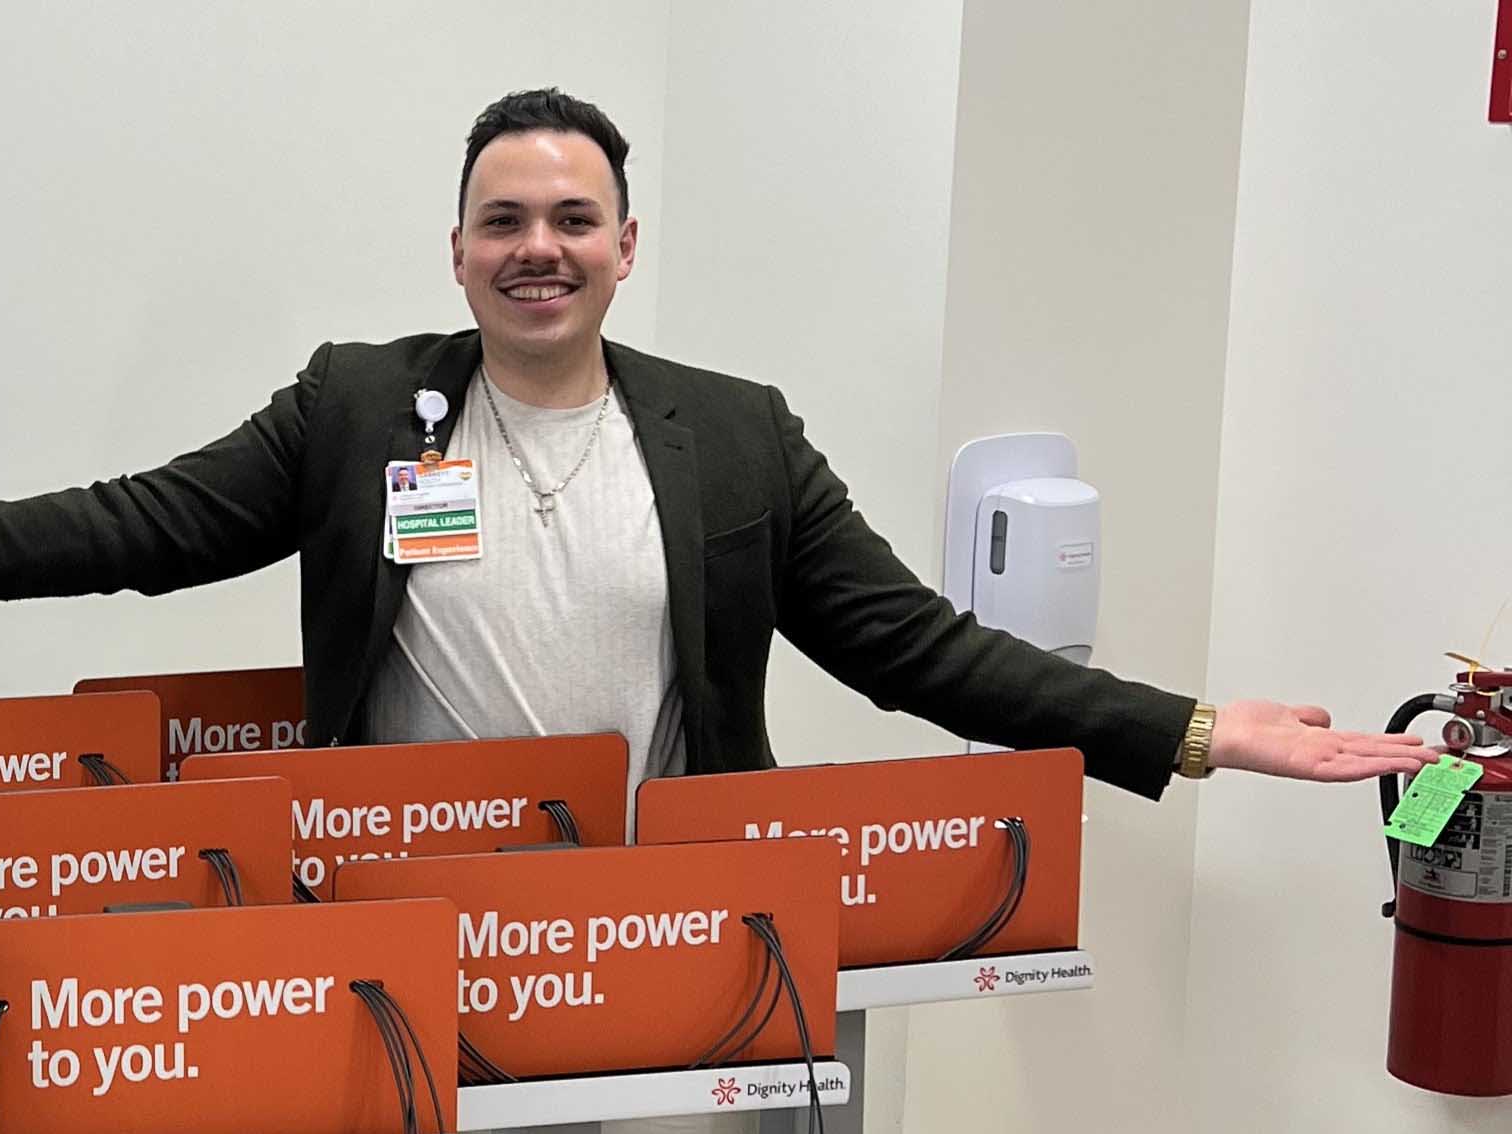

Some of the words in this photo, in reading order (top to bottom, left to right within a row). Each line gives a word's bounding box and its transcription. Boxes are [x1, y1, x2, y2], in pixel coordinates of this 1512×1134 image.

[397, 518, 439, 530] HOSPITAL
[439, 515, 475, 528] LEADER
[168, 717, 262, 755] More
[291, 799, 391, 840] More
[403, 797, 528, 844] power
[860, 816, 985, 866] power
[51, 846, 186, 897] power
[458, 911, 574, 959] More
[587, 909, 729, 963] power
[458, 969, 498, 1013] to
[508, 971, 605, 1022] you.
[1005, 970, 1049, 986] Dignity
[1051, 964, 1091, 979] Health
[31, 977, 163, 1030] More
[178, 976, 335, 1033] power
[27, 1040, 80, 1088] to
[93, 1041, 200, 1097] you.
[747, 1081, 796, 1100] Dignity
[799, 1076, 844, 1093] Halth
